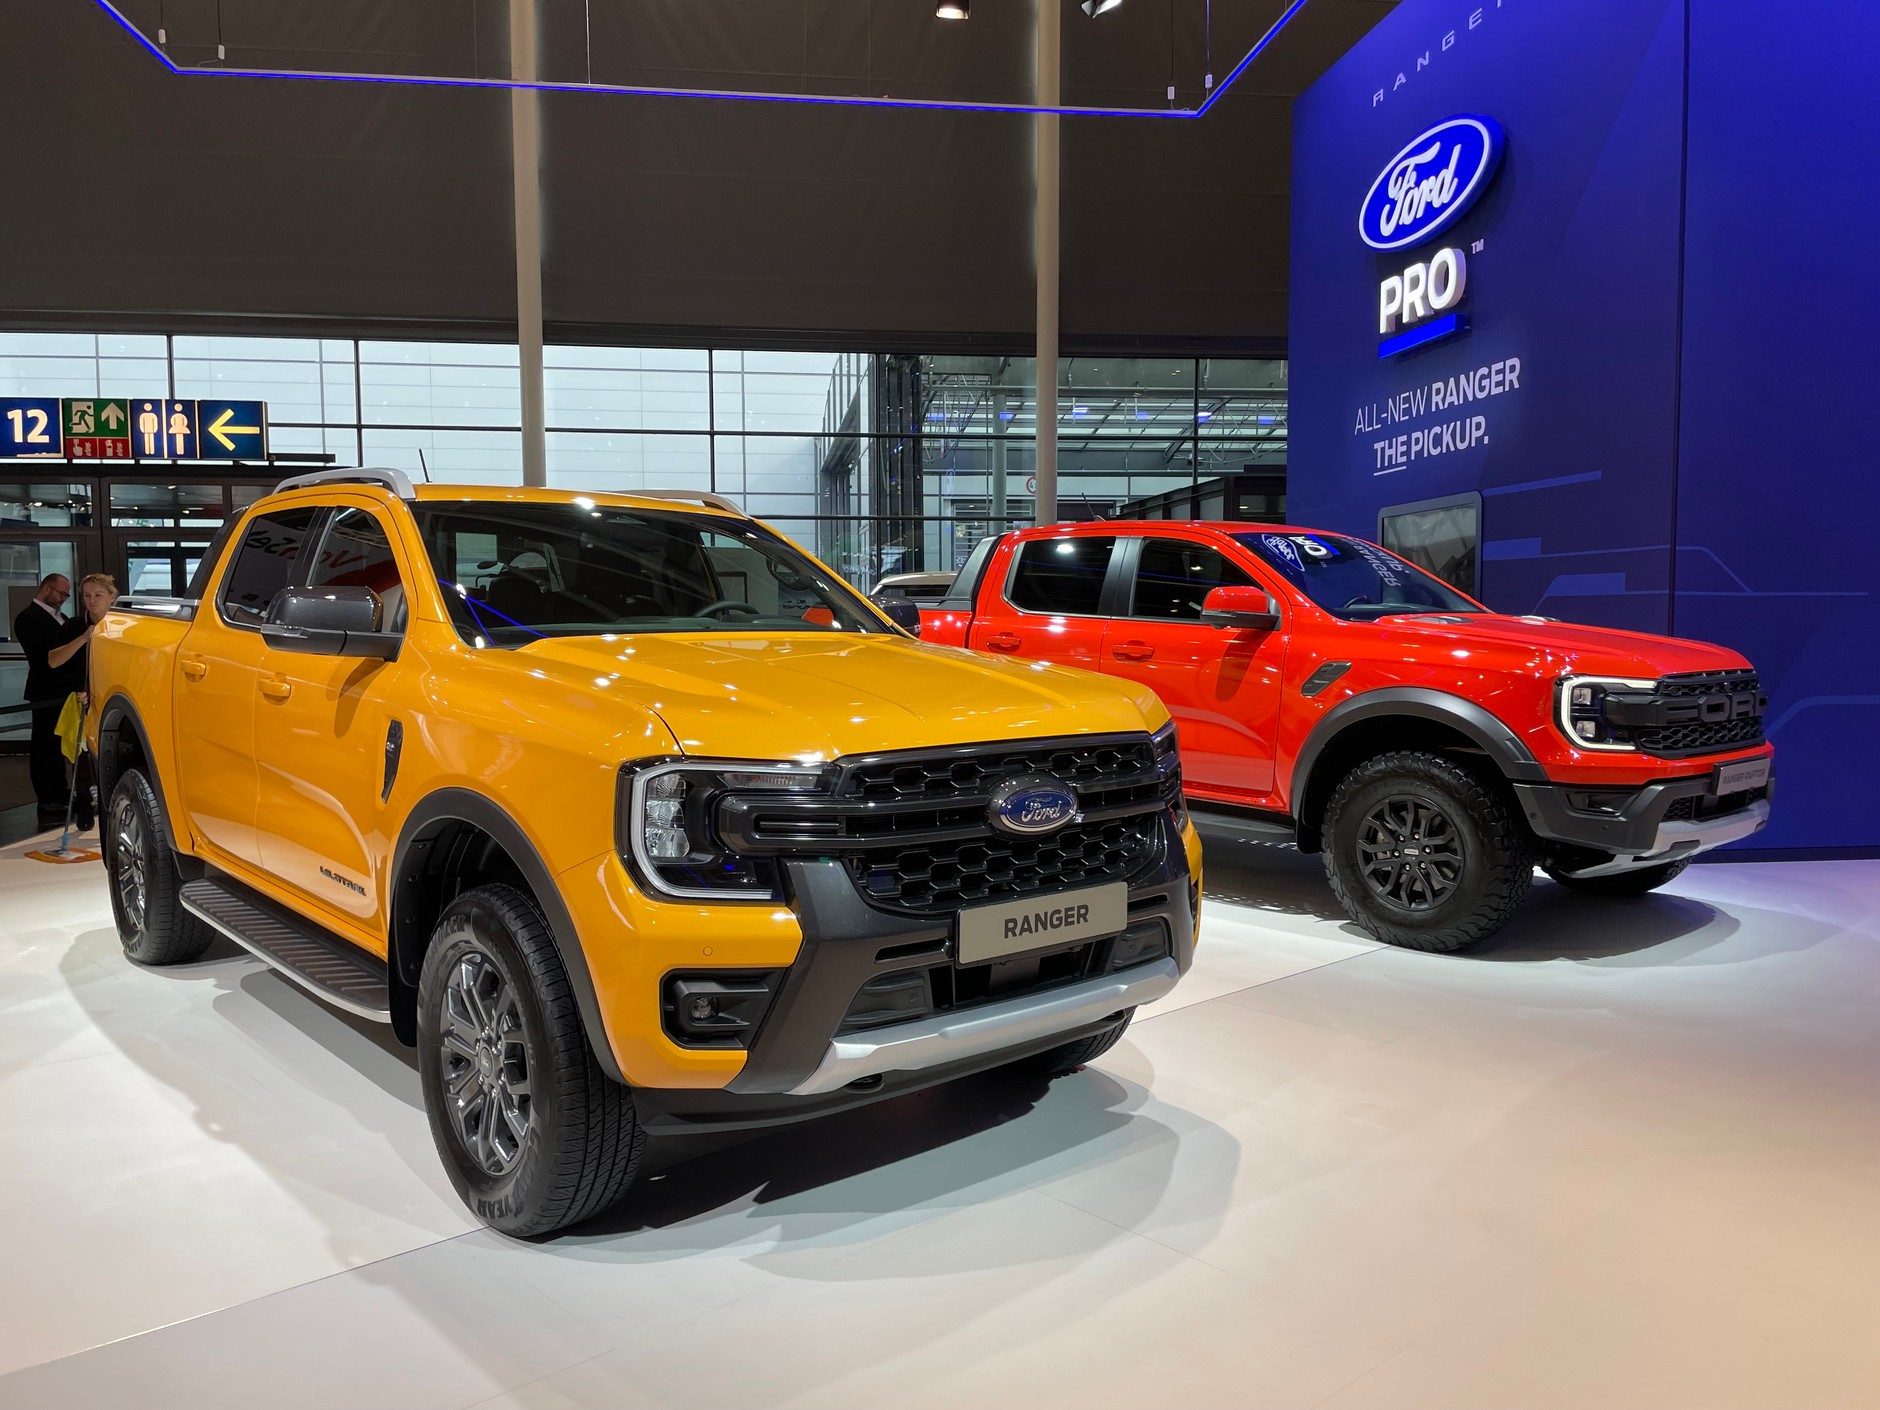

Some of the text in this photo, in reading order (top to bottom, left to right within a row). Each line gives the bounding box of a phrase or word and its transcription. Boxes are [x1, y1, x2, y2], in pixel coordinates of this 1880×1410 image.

[1380, 141, 1461, 237] Ford
[1379, 247, 1465, 334] PRO
[1354, 357, 1521, 435] ALL-NEW RANGER
[7, 408, 50, 443] 12
[1373, 415, 1489, 469] THE PICKUP.
[1021, 797, 1062, 823] Ford
[1003, 904, 1090, 939] RANGER
